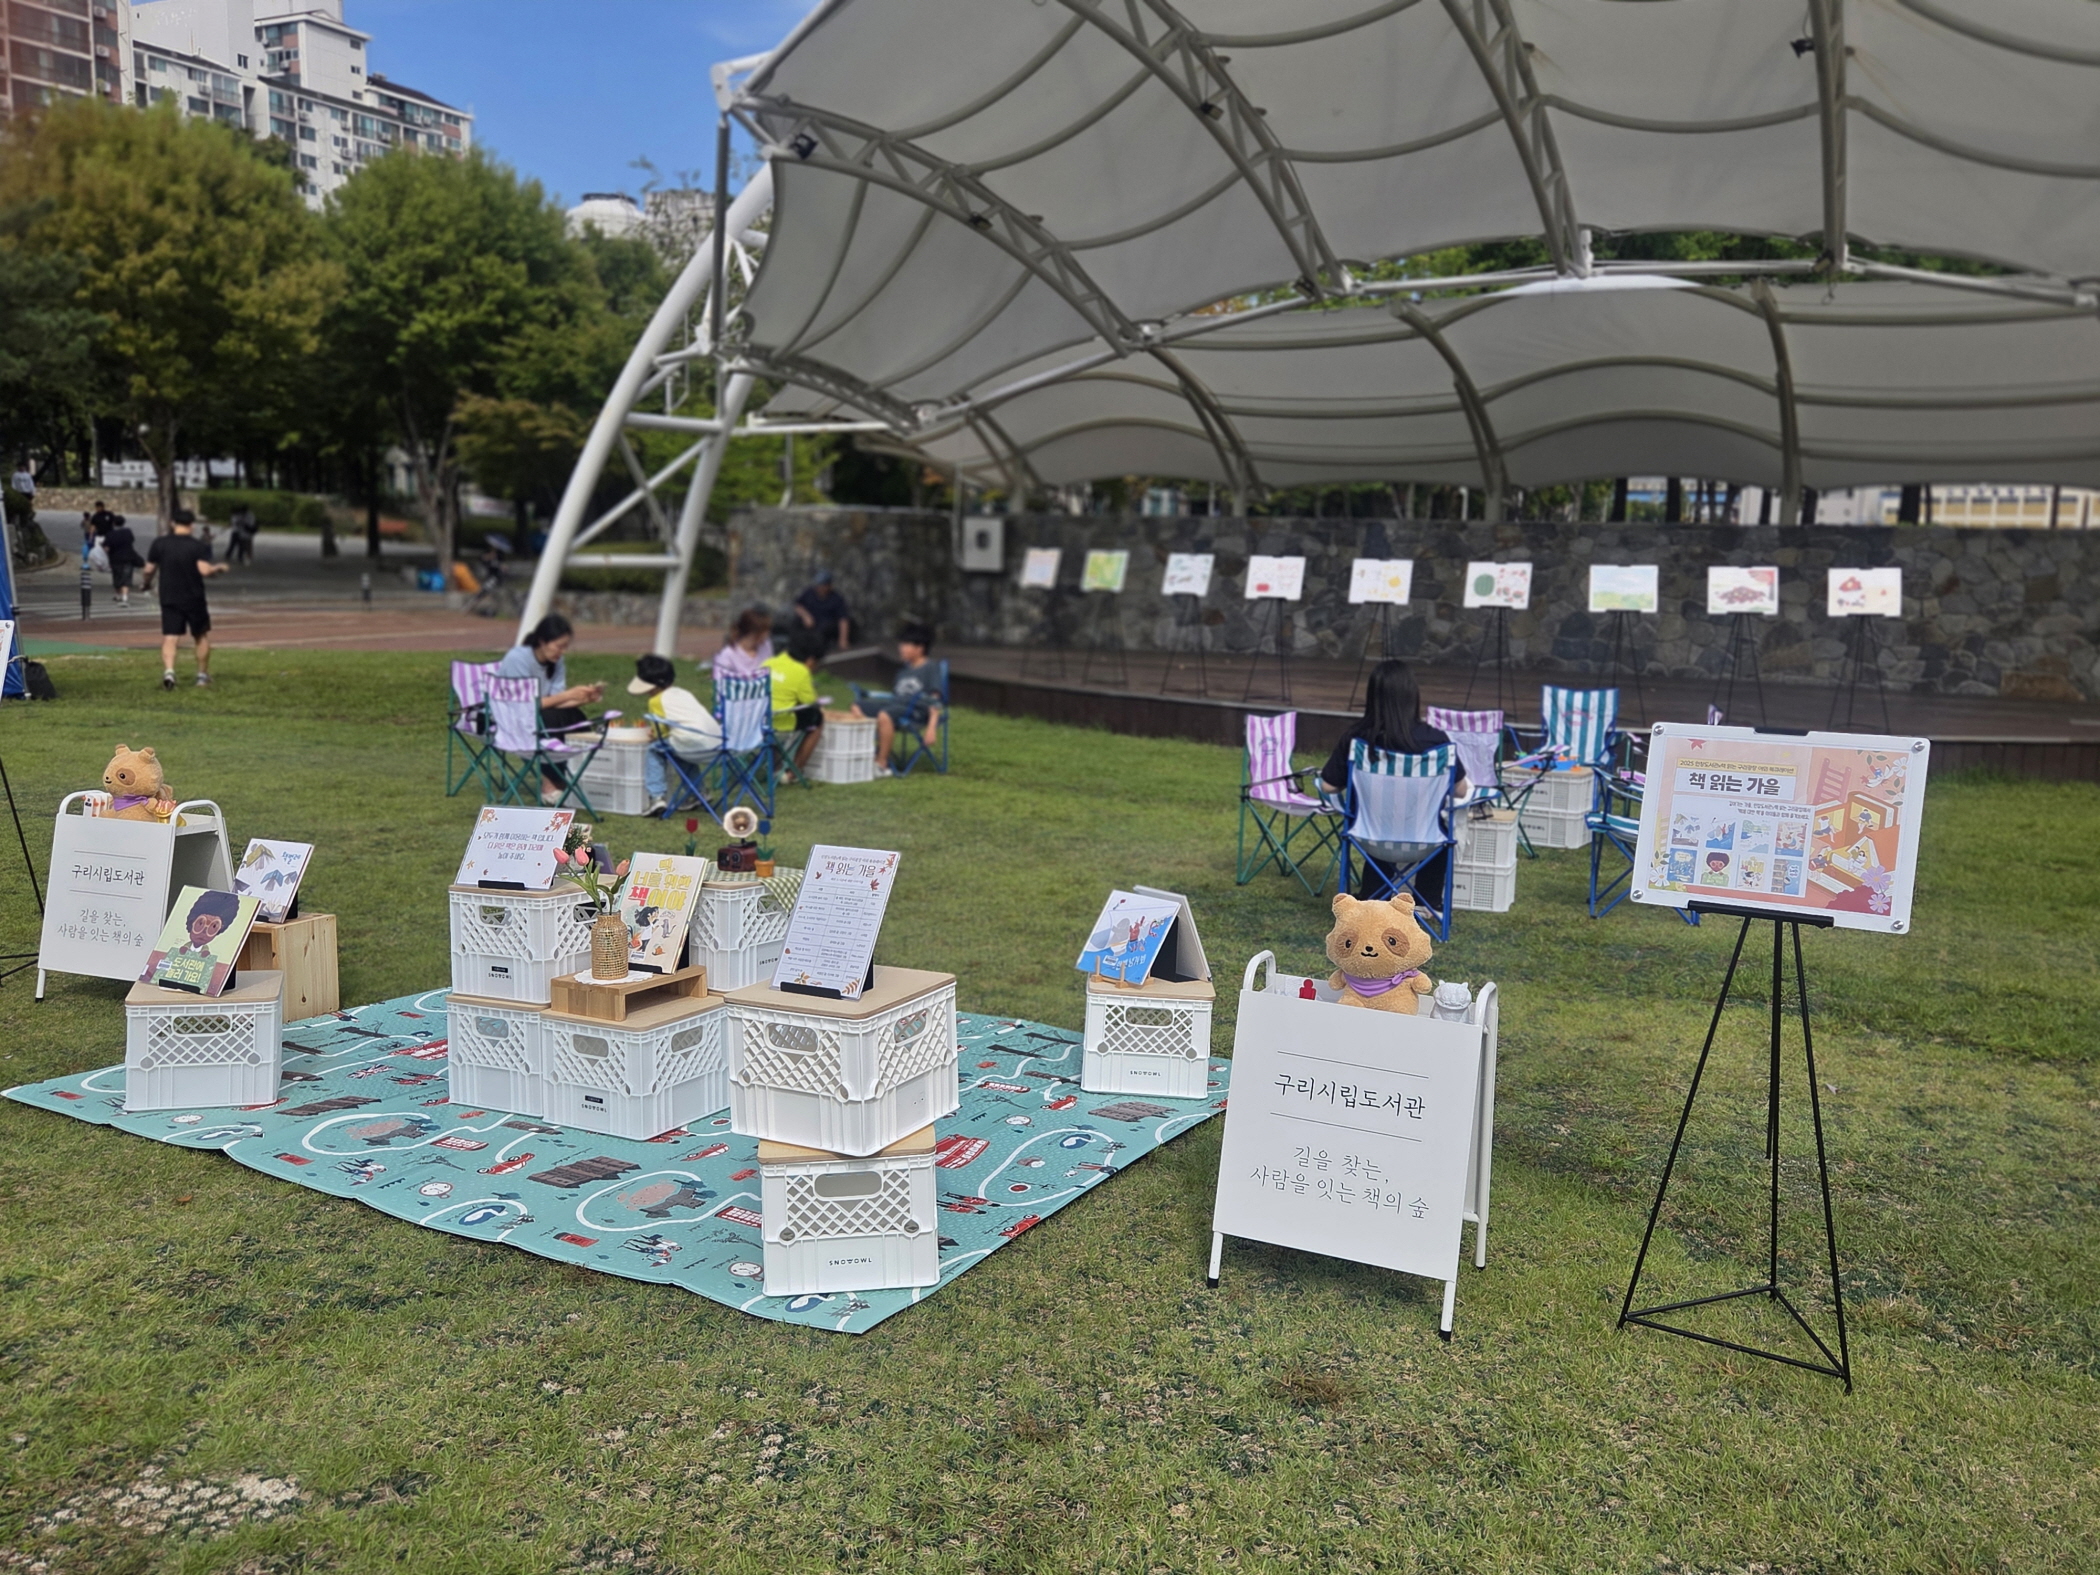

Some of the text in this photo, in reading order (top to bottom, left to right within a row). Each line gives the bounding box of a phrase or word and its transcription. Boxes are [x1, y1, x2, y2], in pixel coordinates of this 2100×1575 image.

[1689, 772, 1780, 796] 책 읽는 가을
[494, 842, 505, 850] 읽은
[499, 832, 509, 840] 함께
[510, 833, 531, 841] 이용하는
[71, 864, 145, 886] 구리시립도서관
[825, 861, 876, 878] 책 읽는 가을
[633, 871, 692, 890] 너를 위한
[628, 886, 687, 910] 책이야
[79, 908, 126, 927] 길을 찾는,
[57, 923, 144, 947] 사람을 잇는 책의 숲
[172, 957, 205, 971] 도서관에
[184, 970, 202, 983] 가요!
[1274, 1073, 1426, 1120] 구리시립도서관
[1294, 1145, 1389, 1184] 길을 찾는,
[1250, 1164, 1430, 1219] 사람을 잇는 책의 숲
[829, 1258, 872, 1266] SNOWOWL
